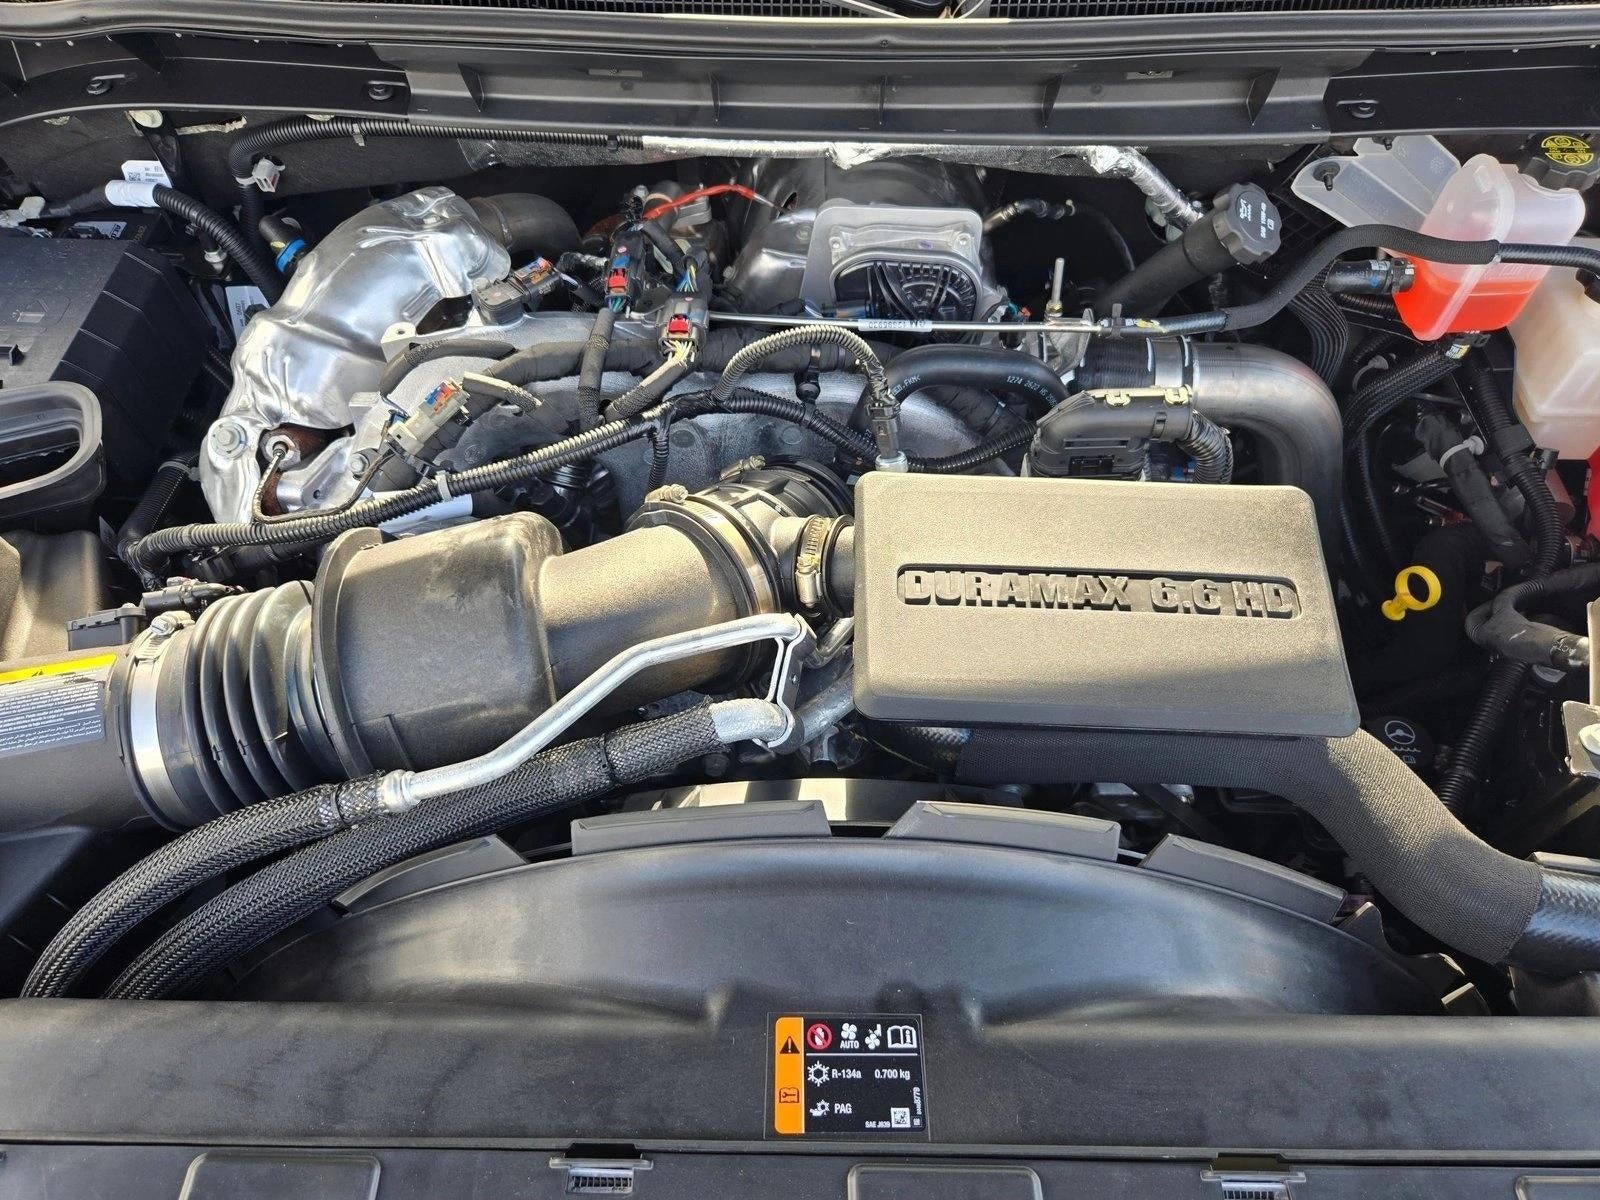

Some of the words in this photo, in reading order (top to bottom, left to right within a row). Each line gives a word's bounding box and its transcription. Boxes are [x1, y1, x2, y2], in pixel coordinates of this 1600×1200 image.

[903, 569, 1132, 611] DURAMAX
[1149, 576, 1222, 615] 6.6
[1233, 581, 1294, 619] HD
[840, 1040, 859, 1049] AUTO
[832, 1069, 862, 1079] R-134a
[874, 1069, 898, 1079] 0.700
[899, 1069, 910, 1080] kg
[834, 1103, 852, 1114] PAG
[864, 1120, 877, 1128] SAE
